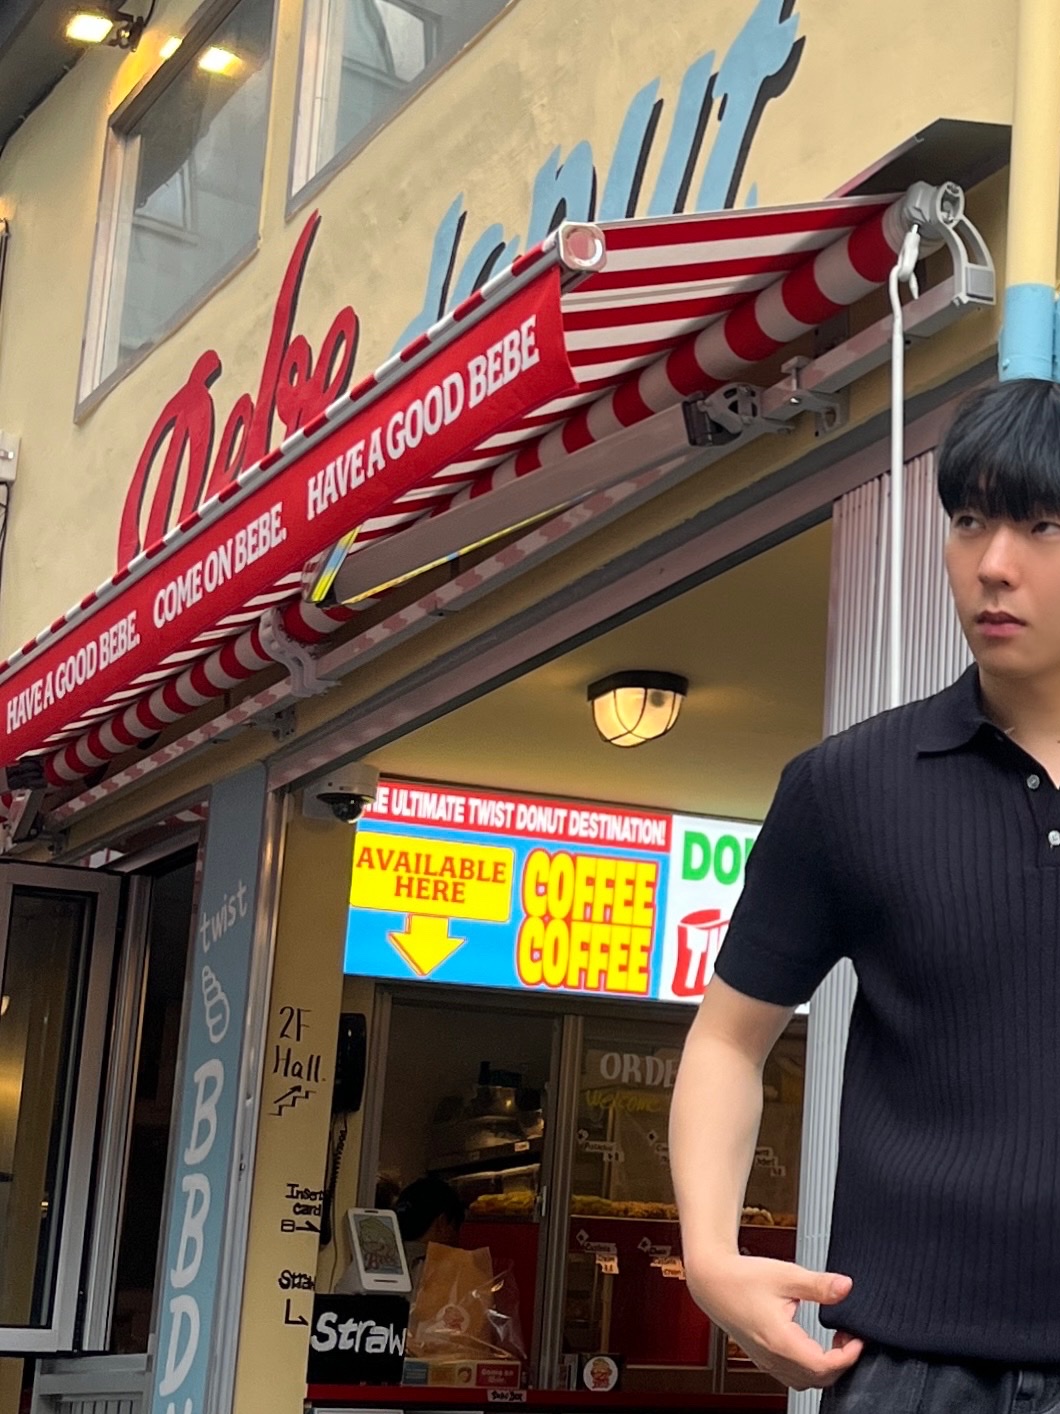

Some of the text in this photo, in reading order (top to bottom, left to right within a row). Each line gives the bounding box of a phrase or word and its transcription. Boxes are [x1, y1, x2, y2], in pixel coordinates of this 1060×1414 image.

[307, 315, 540, 520] HAVE A GOOD BEBE
[153, 501, 287, 628] COME ON BEBE.
[7, 610, 140, 734] HAVE A GOOD BEBE.
[364, 787, 666, 846] HE ULTIMATE TWIST DONUT DESTINATION!
[356, 846, 507, 884] AVAILABLE
[394, 876, 466, 904] HERE
[522, 848, 659, 929] COFFEE
[200, 880, 248, 953] twist
[517, 917, 651, 994] COFFEE
[278, 1006, 313, 1043] 2F
[311, 1312, 407, 1356] Straw
